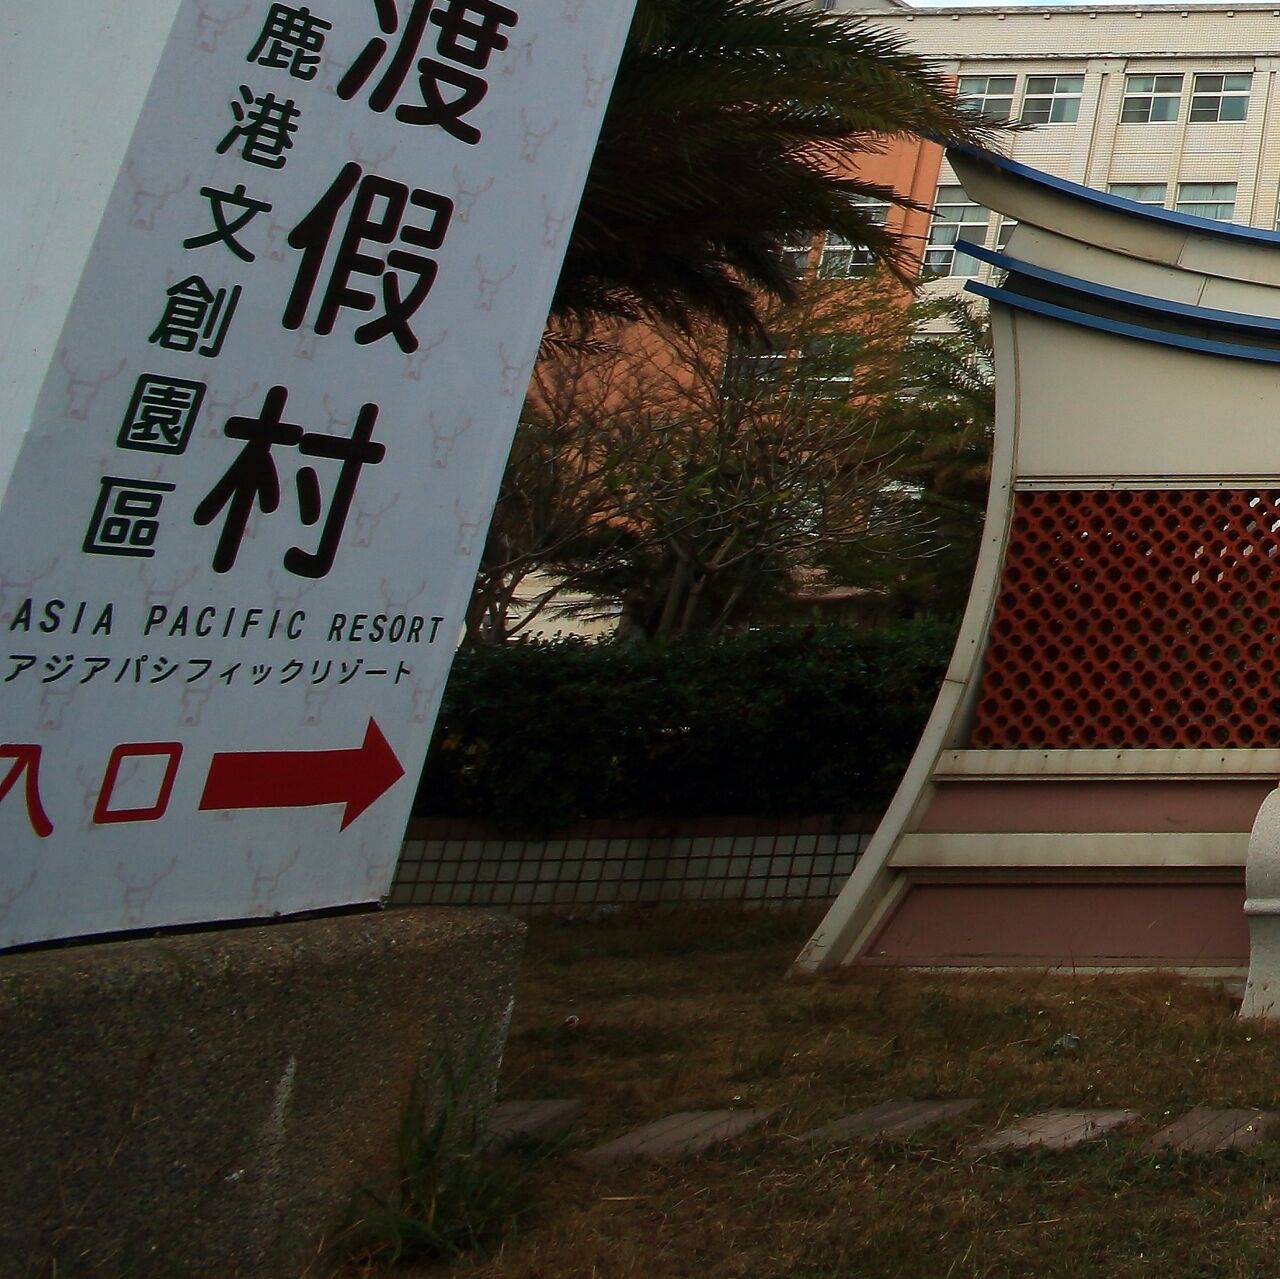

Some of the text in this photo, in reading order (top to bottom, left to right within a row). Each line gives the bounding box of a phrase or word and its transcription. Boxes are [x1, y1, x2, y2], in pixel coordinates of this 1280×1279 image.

[83, 3, 333, 558] 鹿港文創園區
[10, 598, 444, 644] ASIA PACIFIC RESORT
[4, 654, 412, 686] アジアパシフィックリゾート
[0, 743, 183, 838] 入口
